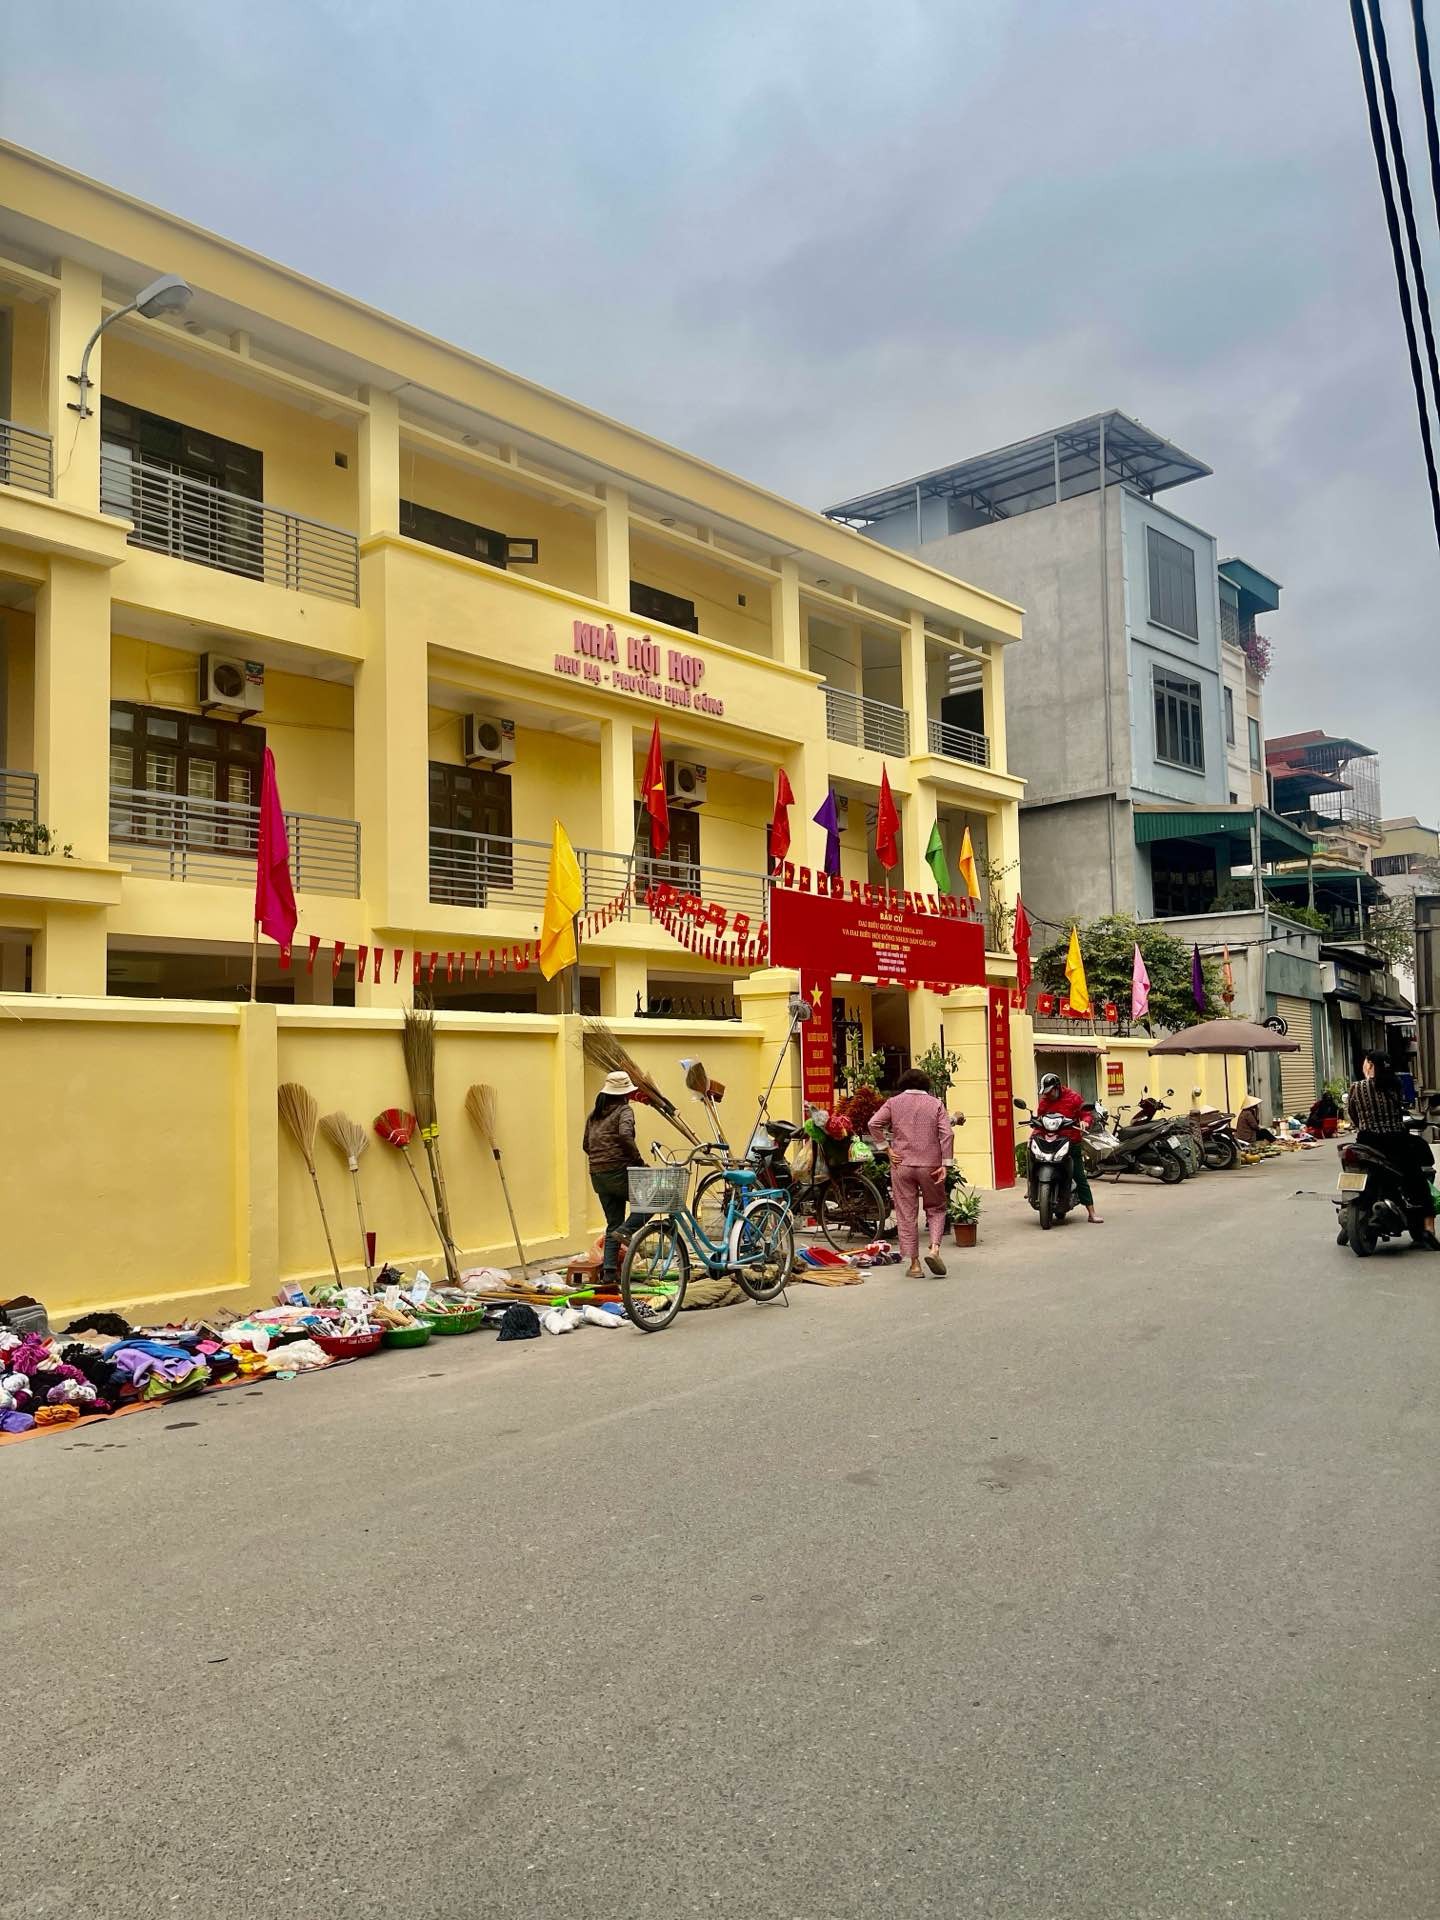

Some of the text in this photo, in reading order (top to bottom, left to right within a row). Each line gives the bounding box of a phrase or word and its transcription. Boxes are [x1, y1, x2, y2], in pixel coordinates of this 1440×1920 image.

[574, 620, 705, 690] NHÀ HỘI HỌP
